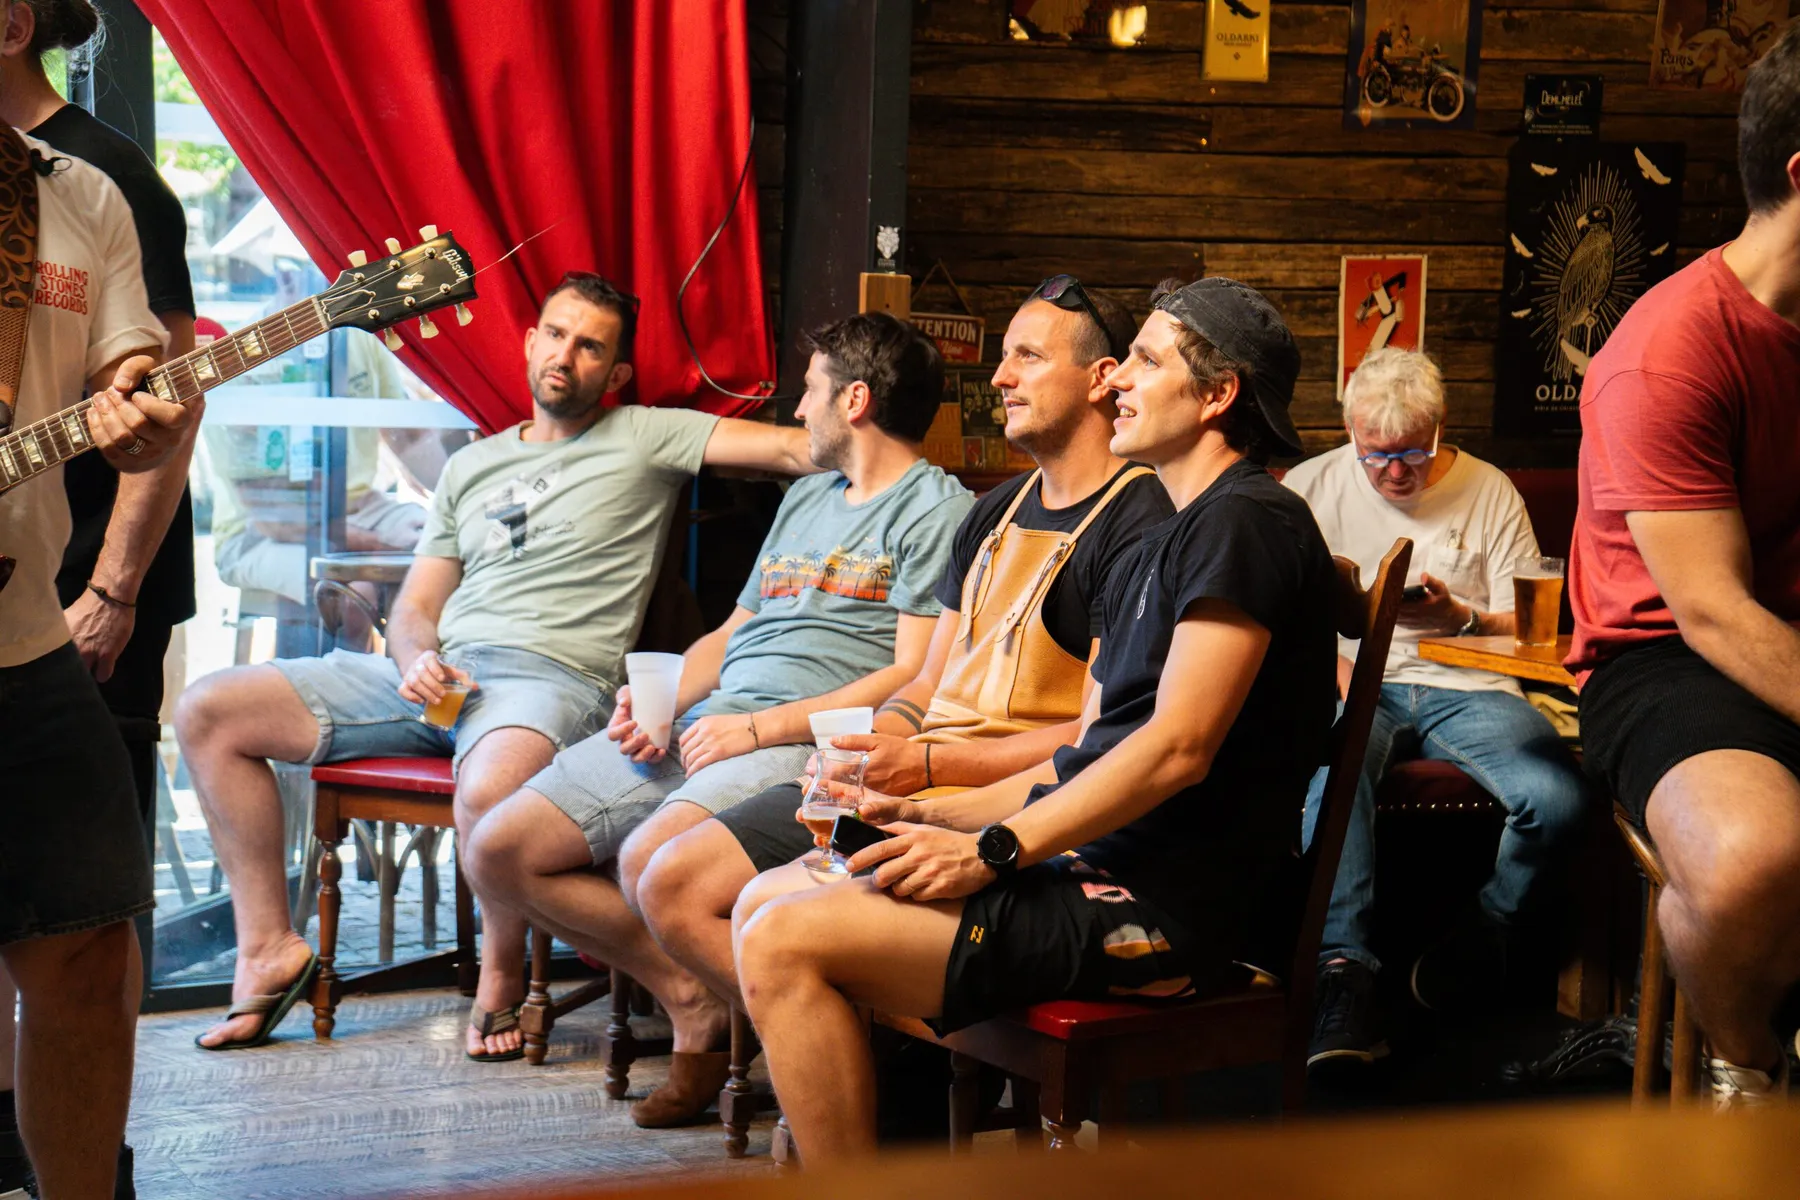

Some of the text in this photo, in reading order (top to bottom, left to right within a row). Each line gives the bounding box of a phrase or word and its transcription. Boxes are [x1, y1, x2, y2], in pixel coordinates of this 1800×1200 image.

[35, 260, 88, 286] ROLLING
[40, 275, 86, 299] STONES
[34, 289, 88, 316] RECORDS
[910, 319, 977, 342] TENTION
[1535, 384, 1581, 402] OLD
